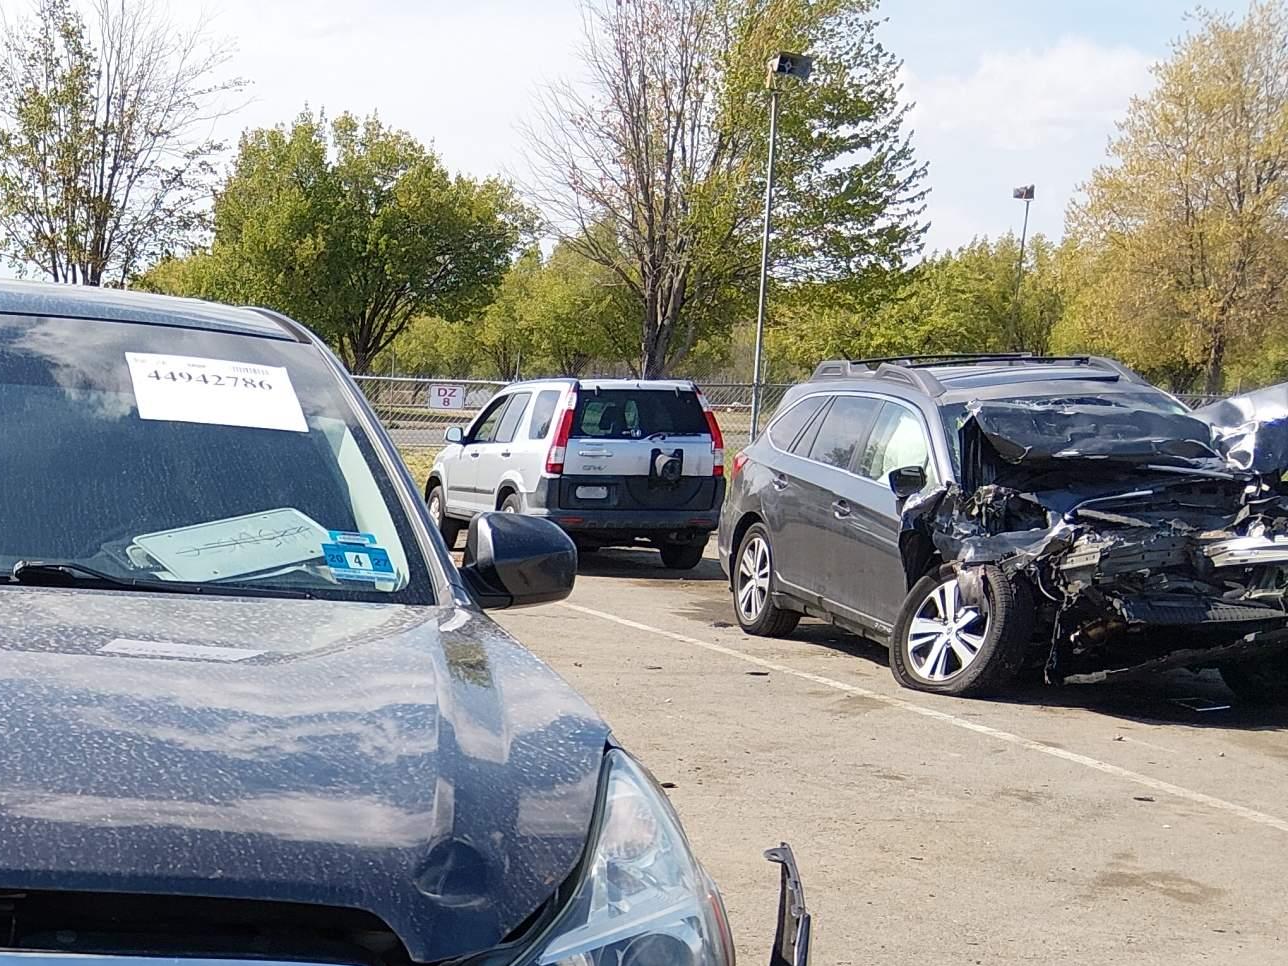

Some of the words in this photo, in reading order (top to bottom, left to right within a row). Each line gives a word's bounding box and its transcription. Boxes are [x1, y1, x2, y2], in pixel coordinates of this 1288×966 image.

[147, 369, 273, 391] 44942786
[437, 387, 457, 398] DZ
[442, 397, 450, 407] 8
[328, 553, 344, 563] 20
[354, 554, 363, 567] 4
[373, 558, 388, 567] 27
